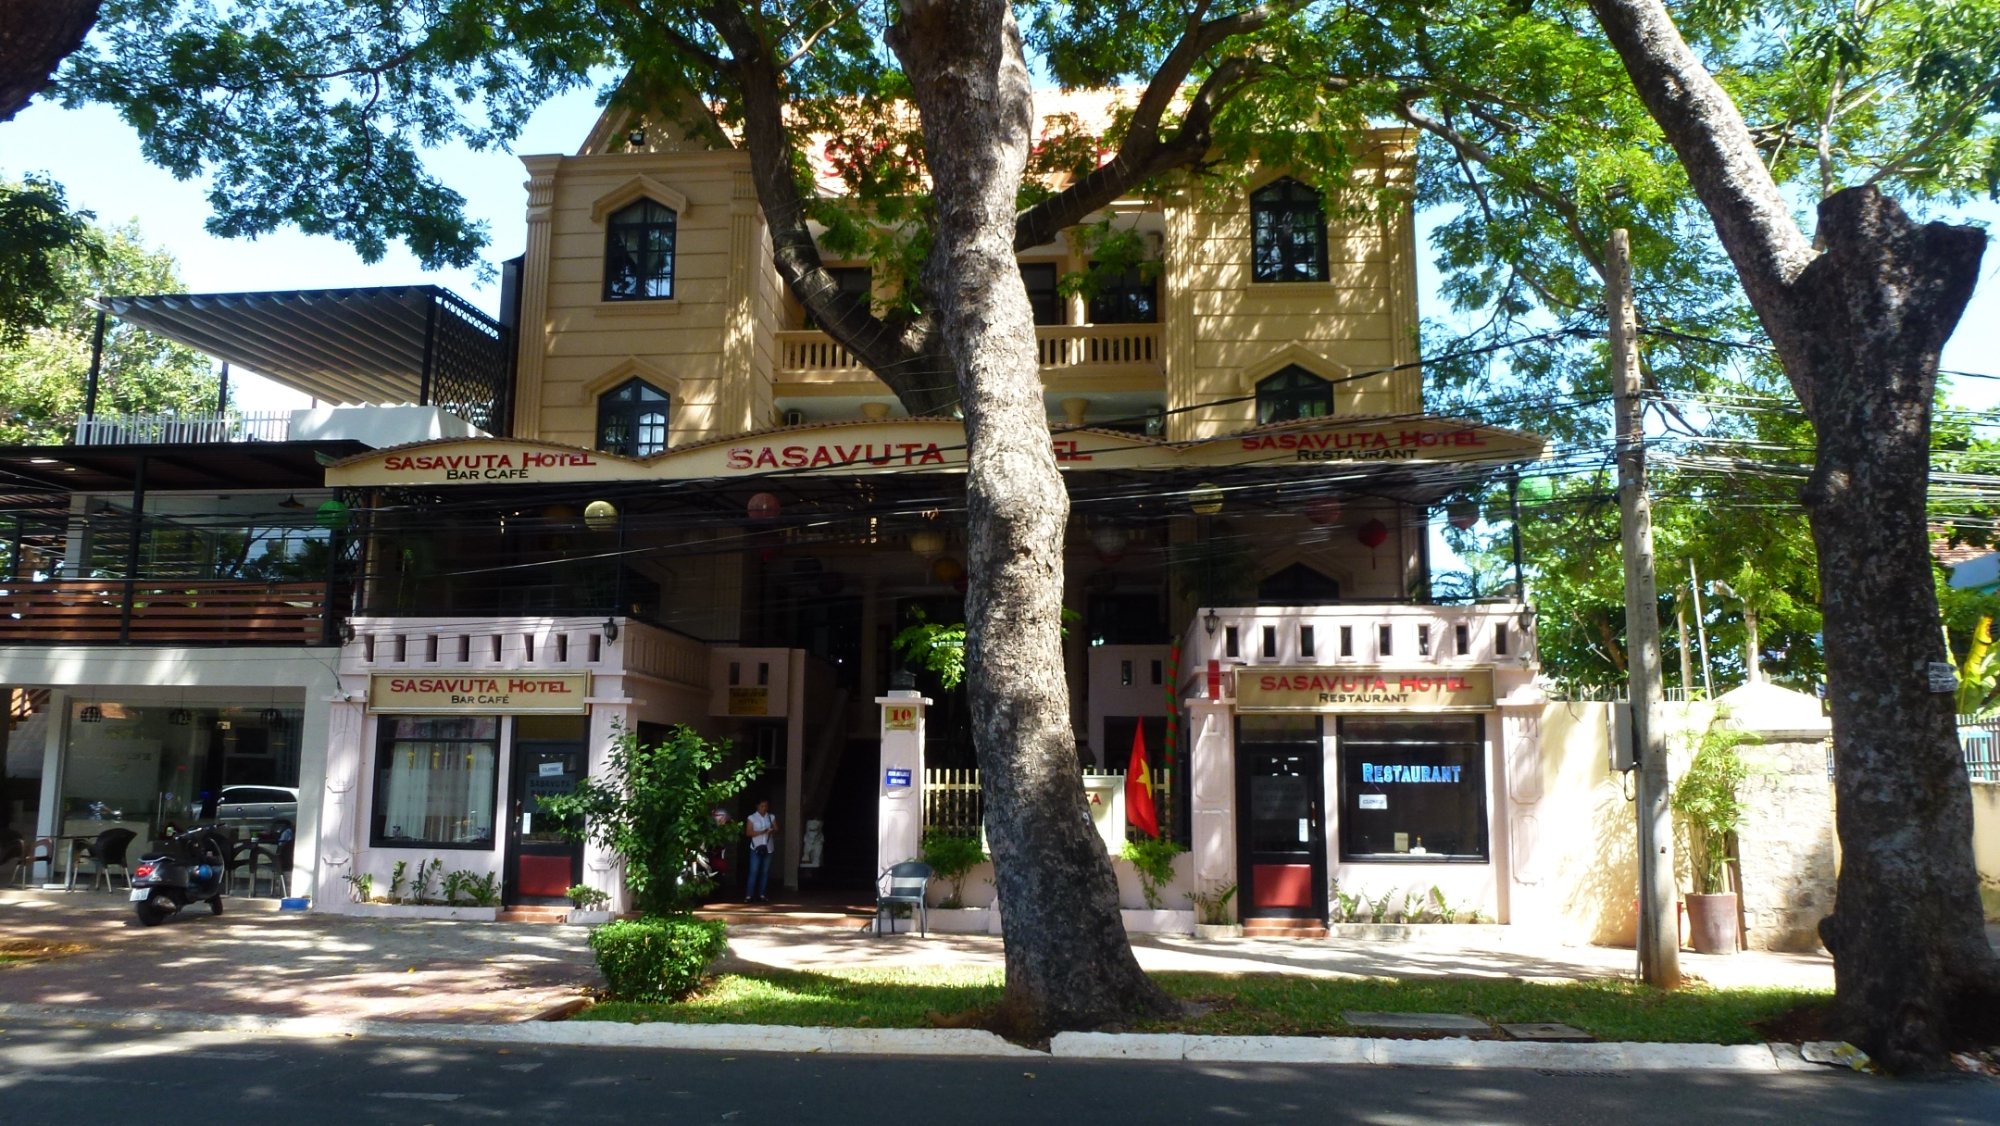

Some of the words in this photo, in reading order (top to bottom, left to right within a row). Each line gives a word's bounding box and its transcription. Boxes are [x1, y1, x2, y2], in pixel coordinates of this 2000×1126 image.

[1242, 432, 1387, 450] SASAVUTA
[1399, 431, 1487, 447] HOTEL
[384, 454, 512, 470] SASAVUTA
[522, 452, 597, 468] HOTEL
[726, 442, 945, 469] SASAVUTA
[1297, 449, 1418, 461] RESTAURANT
[447, 469, 479, 480] BAR
[484, 467, 529, 479] CAFÉ
[390, 679, 499, 693] SASAVUTA
[508, 679, 572, 693] HOTEL
[1259, 675, 1387, 692] SASAVUTA
[1400, 675, 1474, 692] HOTEL
[451, 695, 475, 704] BAR
[477, 694, 510, 704] CAFÉ
[1319, 693, 1409, 703] RESTAURANT
[892, 709, 912, 721] 10
[1362, 763, 1461, 783] RESTAURANT
